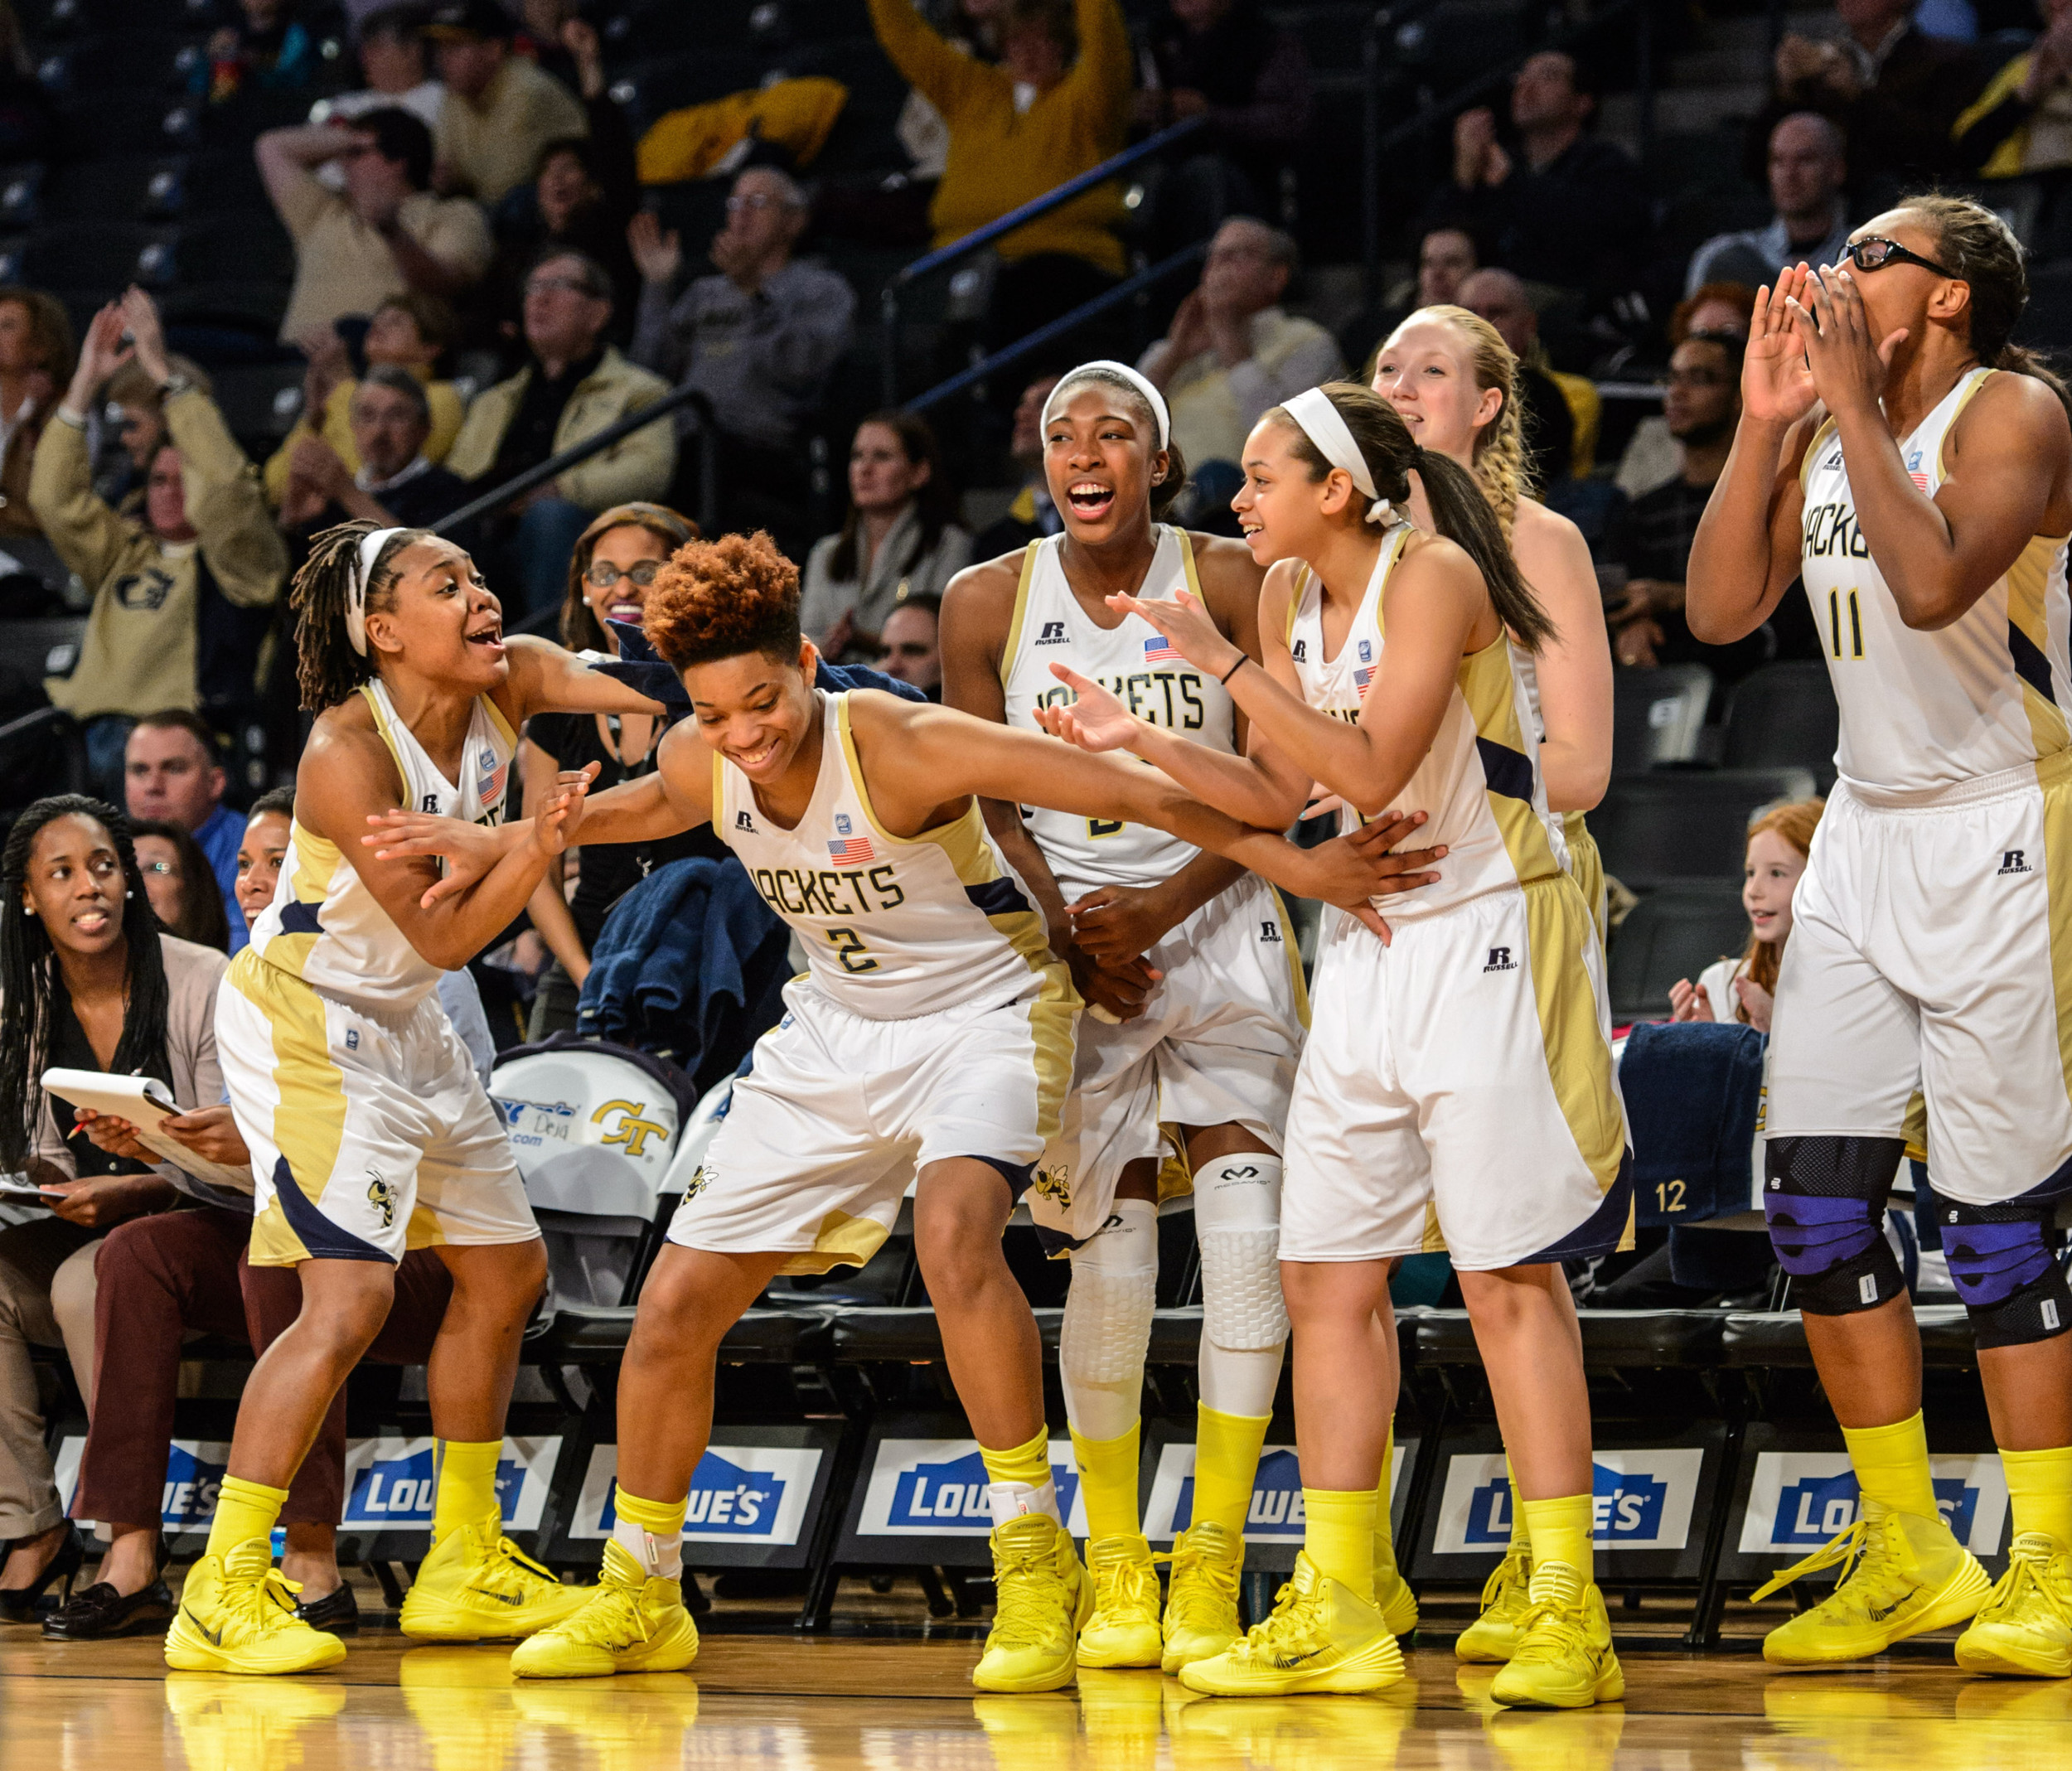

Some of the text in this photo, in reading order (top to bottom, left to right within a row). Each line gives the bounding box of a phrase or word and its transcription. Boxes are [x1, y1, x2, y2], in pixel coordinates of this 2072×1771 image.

[1828, 588, 1865, 660] 11
[1034, 637, 1071, 646] RUSSELL
[1997, 865, 2033, 875] RUSSELL
[826, 927, 879, 973] 2
[1483, 961, 1519, 974] RUSSELL
[1655, 1178, 1687, 1212] 12
